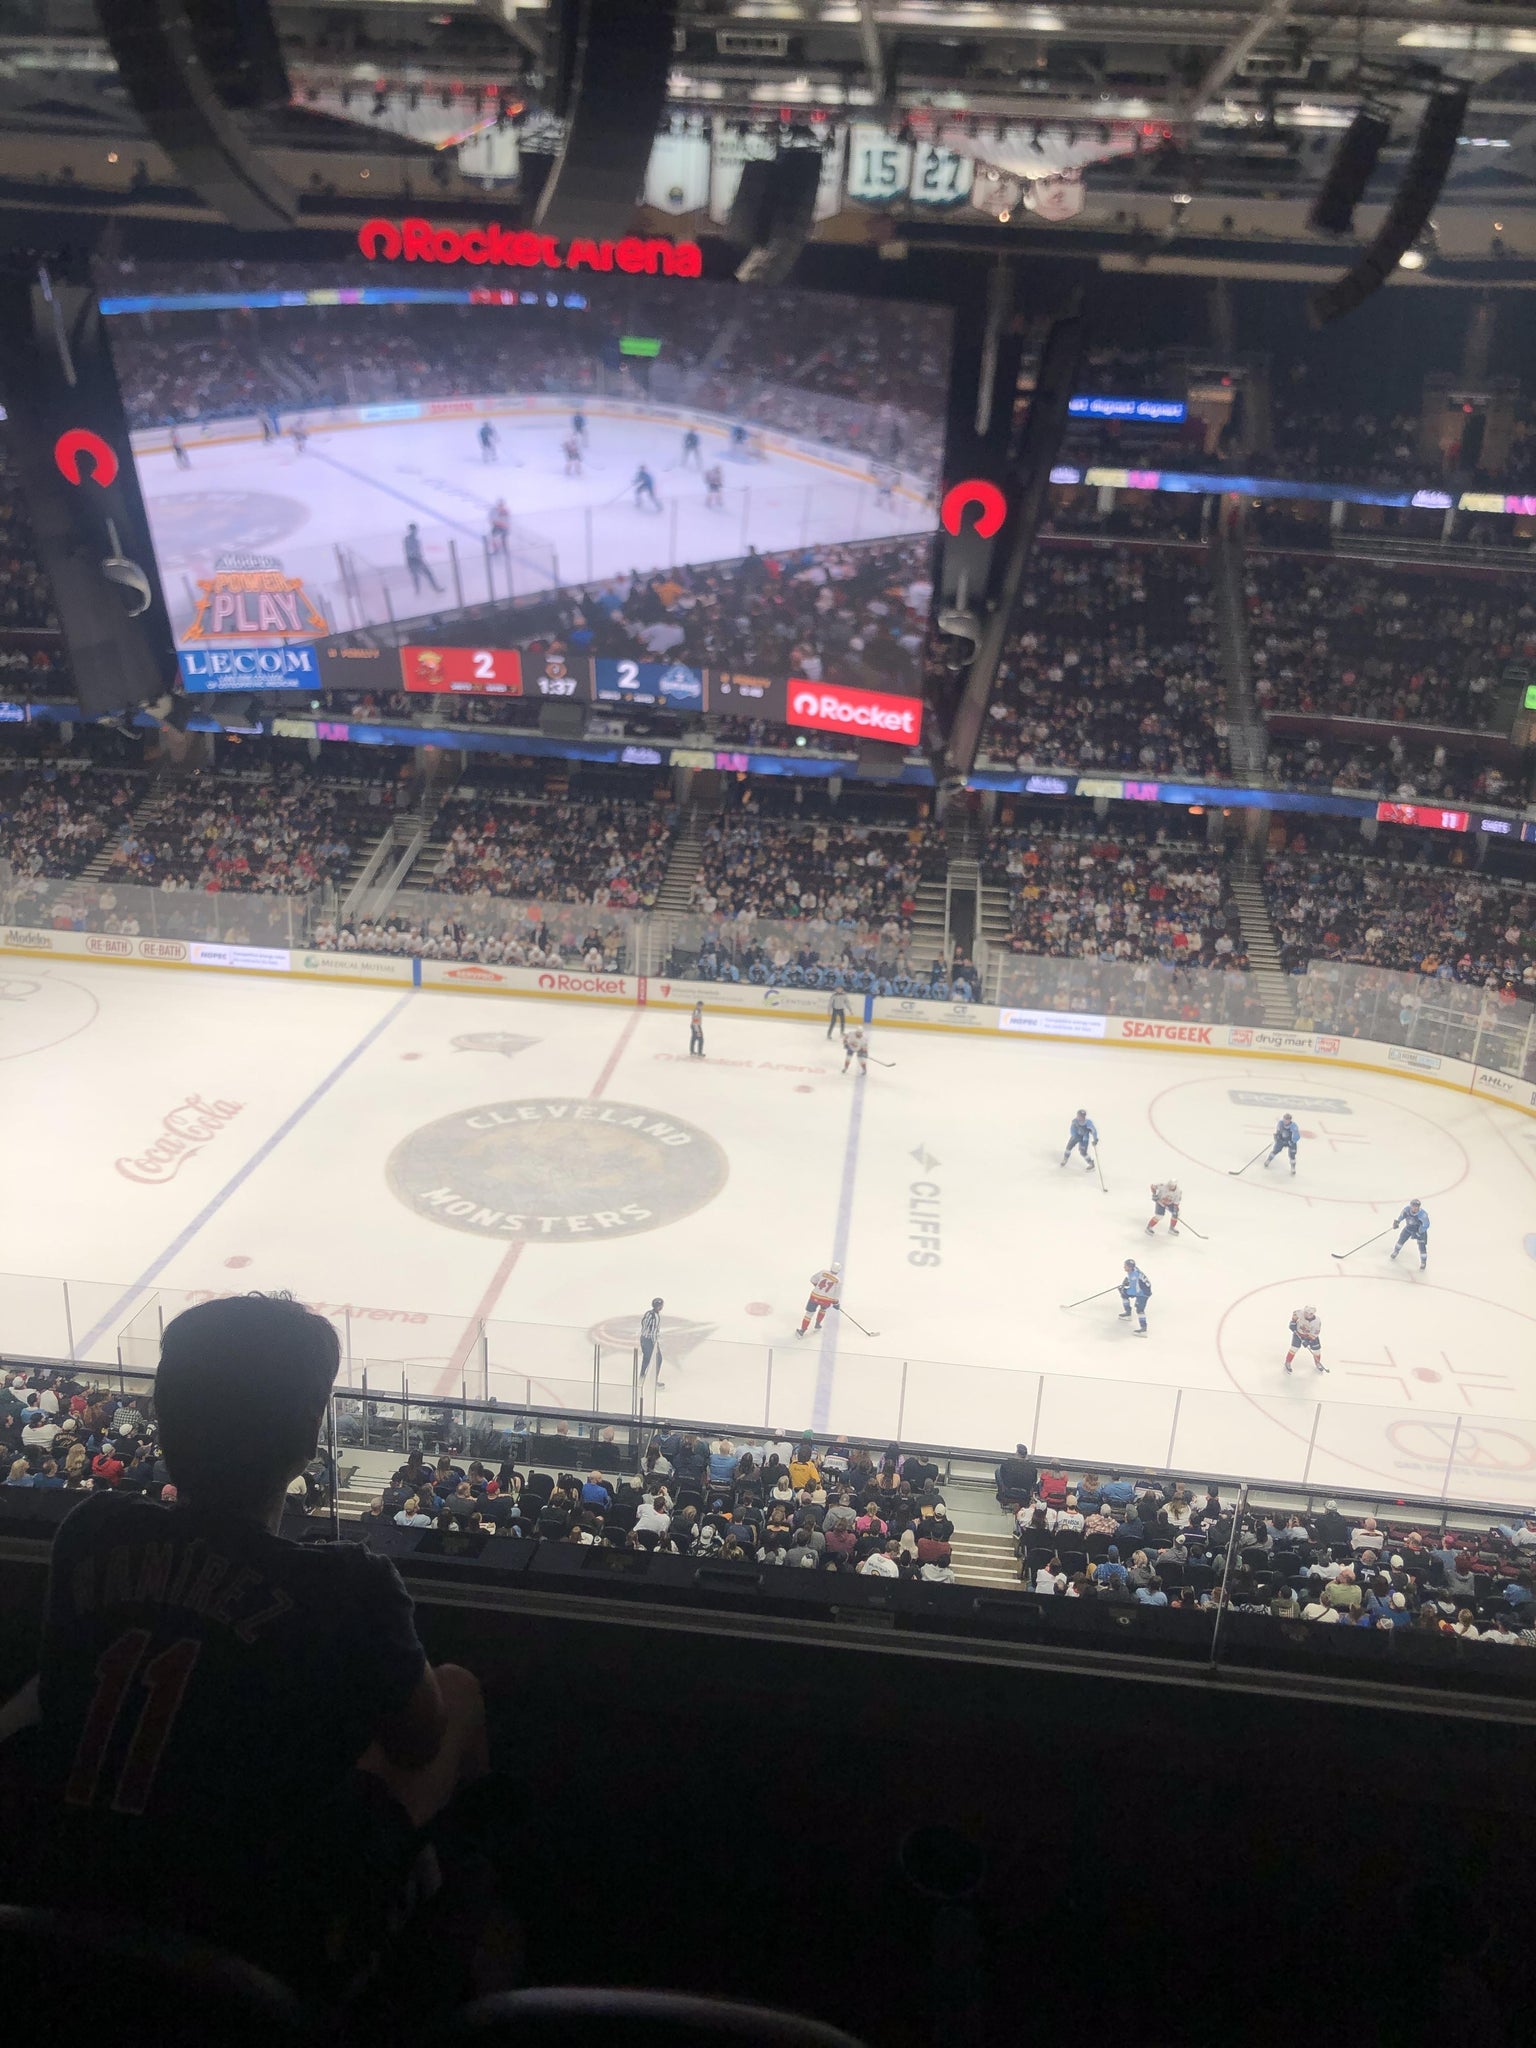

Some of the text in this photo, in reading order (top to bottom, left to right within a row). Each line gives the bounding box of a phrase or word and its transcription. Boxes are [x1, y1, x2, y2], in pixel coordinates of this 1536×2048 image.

[864, 150, 897, 184] 15
[923, 150, 962, 190] 27
[402, 218, 702, 278] Rocket Arena
[214, 572, 292, 593] POWER
[212, 593, 303, 632] PLAY
[185, 651, 313, 675] LECOM
[472, 651, 496, 679] 2
[617, 660, 641, 689] 2
[537, 677, 577, 696] 1:37
[819, 694, 914, 734] Rocket
[558, 974, 626, 995] Rocket
[1122, 1020, 1213, 1045] SEATGEEK
[1255, 1033, 1283, 1047] drug
[1285, 1038, 1313, 1048] mart
[465, 1104, 691, 1147] CLEVELAND
[419, 1187, 653, 1233] MONSTERS
[907, 1180, 942, 1268] CLIFFS
[330, 1302, 429, 1324] Arena
[64, 1628, 201, 1816] 11
